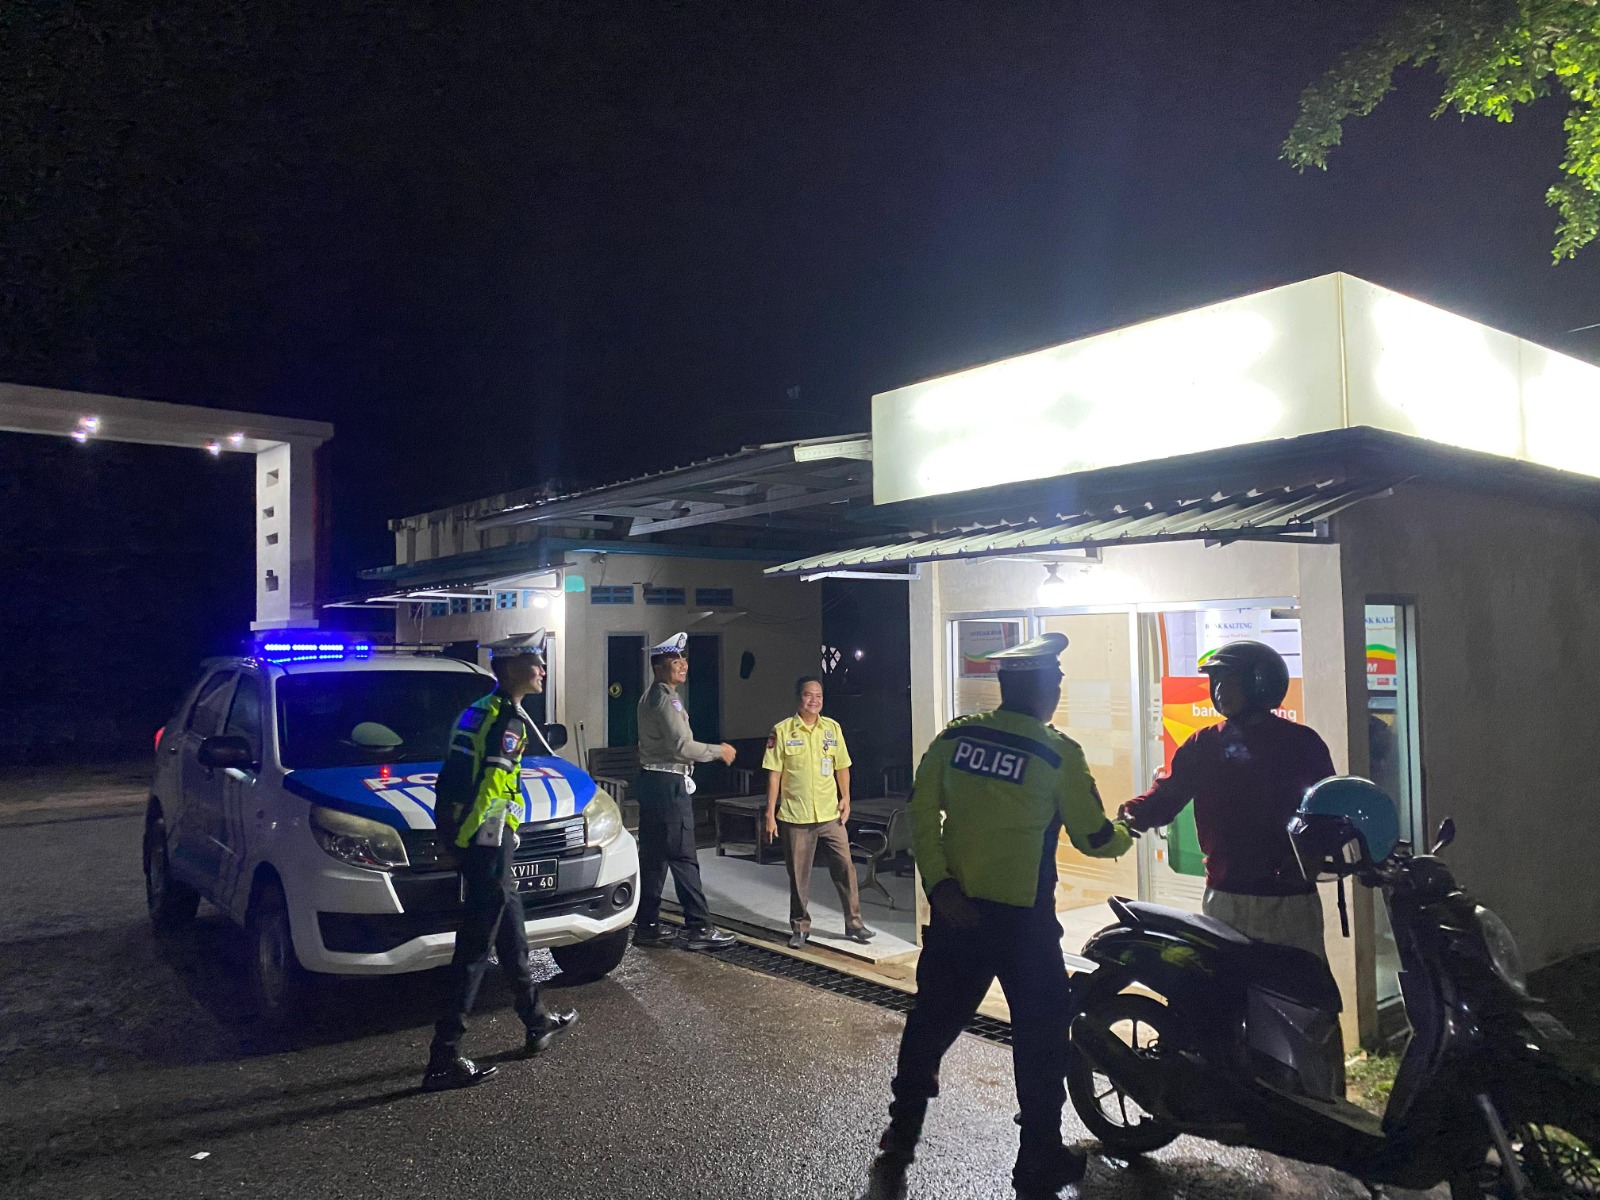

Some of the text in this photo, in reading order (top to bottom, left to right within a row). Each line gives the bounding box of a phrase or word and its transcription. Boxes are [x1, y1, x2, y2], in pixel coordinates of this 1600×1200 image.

[1192, 704, 1221, 717] ban
[954, 742, 1025, 779] POLISI
[363, 767, 564, 791] POSI
